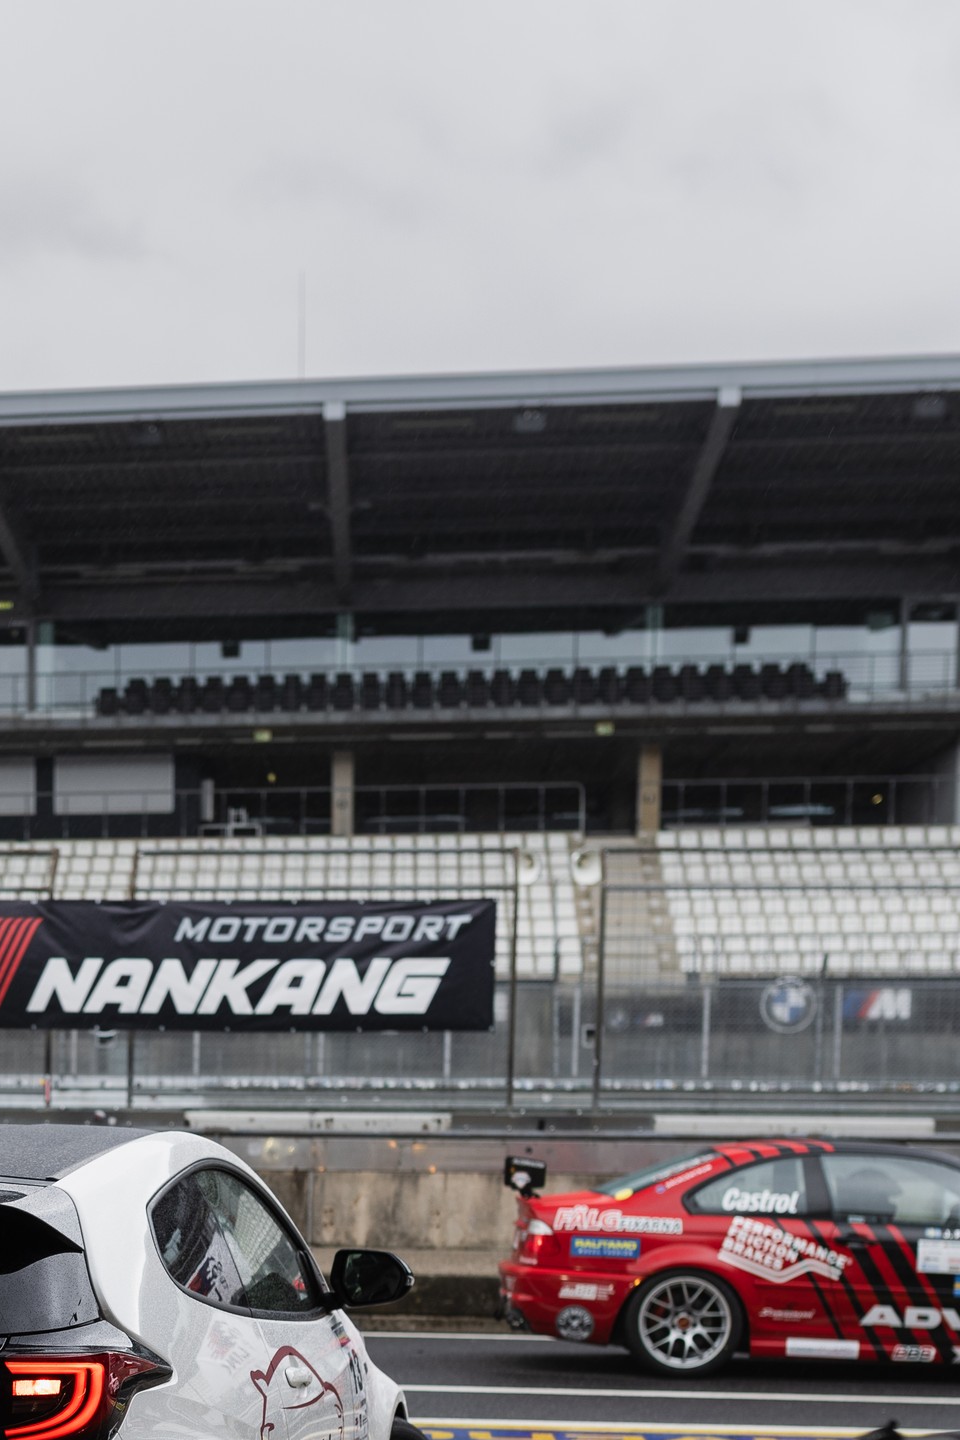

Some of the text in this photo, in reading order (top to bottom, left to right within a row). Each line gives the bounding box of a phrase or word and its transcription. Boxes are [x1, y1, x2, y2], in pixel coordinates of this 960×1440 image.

[174, 914, 473, 943] MOTORSPORT
[26, 957, 451, 1016] NANKANG
[721, 1187, 800, 1214] Castrol
[722, 1236, 784, 1271] BRAKES
[727, 1225, 799, 1264] FRICTION
[732, 1215, 848, 1270] PERFORMANCE
